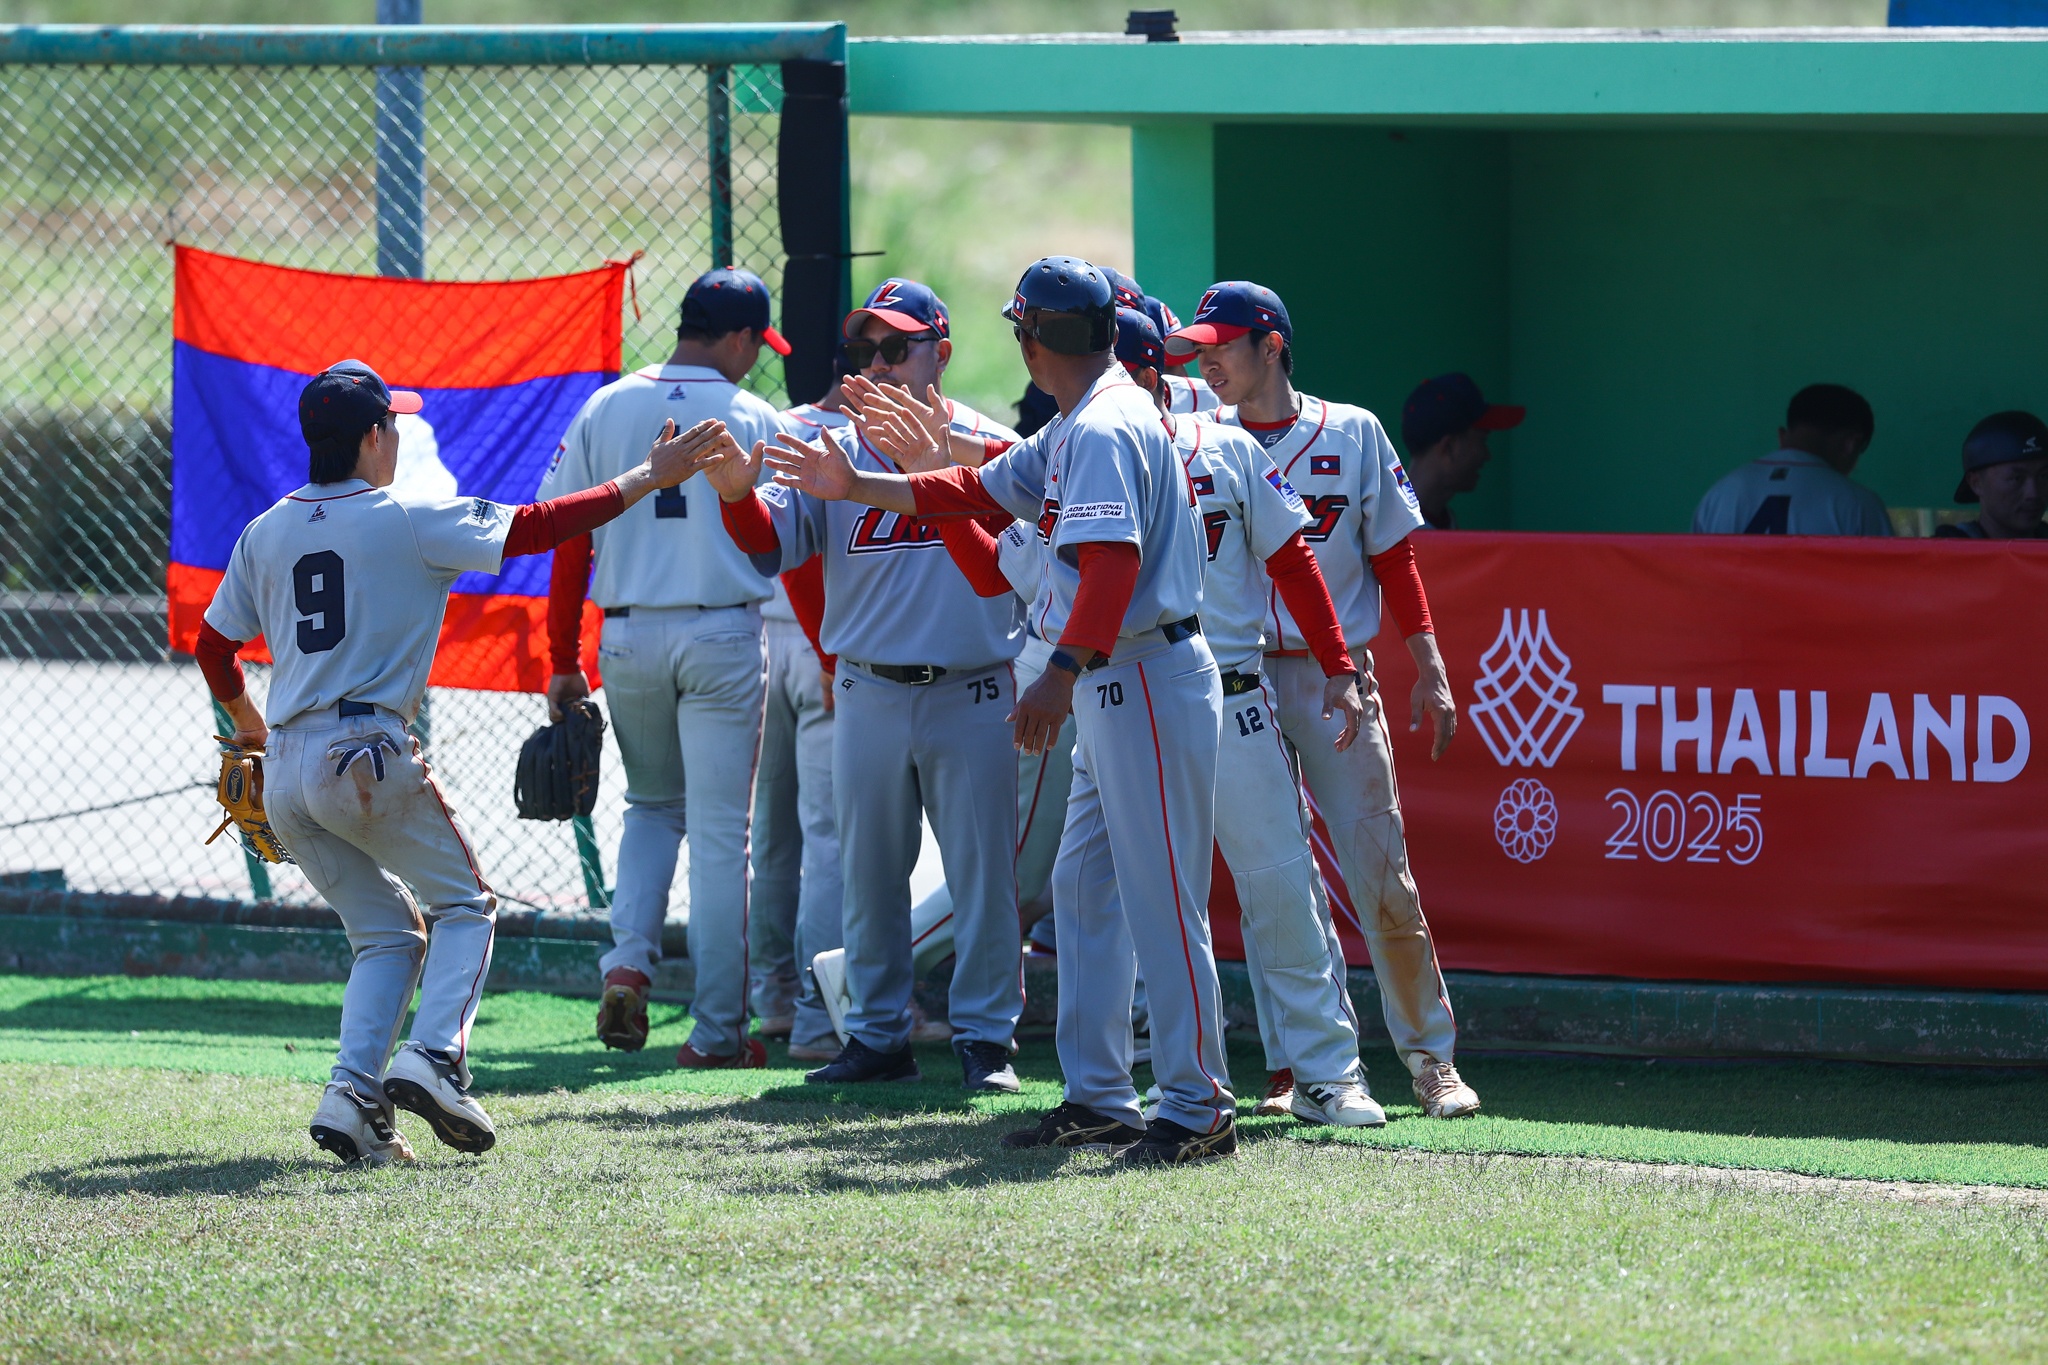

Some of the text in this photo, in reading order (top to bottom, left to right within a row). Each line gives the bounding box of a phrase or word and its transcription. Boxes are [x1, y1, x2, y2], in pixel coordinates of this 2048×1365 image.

[868, 281, 903, 309] L
[1193, 290, 1220, 324] L
[1009, 526, 1026, 546] ATIONAL
[293, 549, 346, 655] 9
[967, 677, 999, 704] 75
[1096, 681, 1124, 709] 70
[1235, 706, 1265, 737] 12
[1602, 684, 2031, 783] THAILAND
[1604, 788, 1763, 865] 2025
